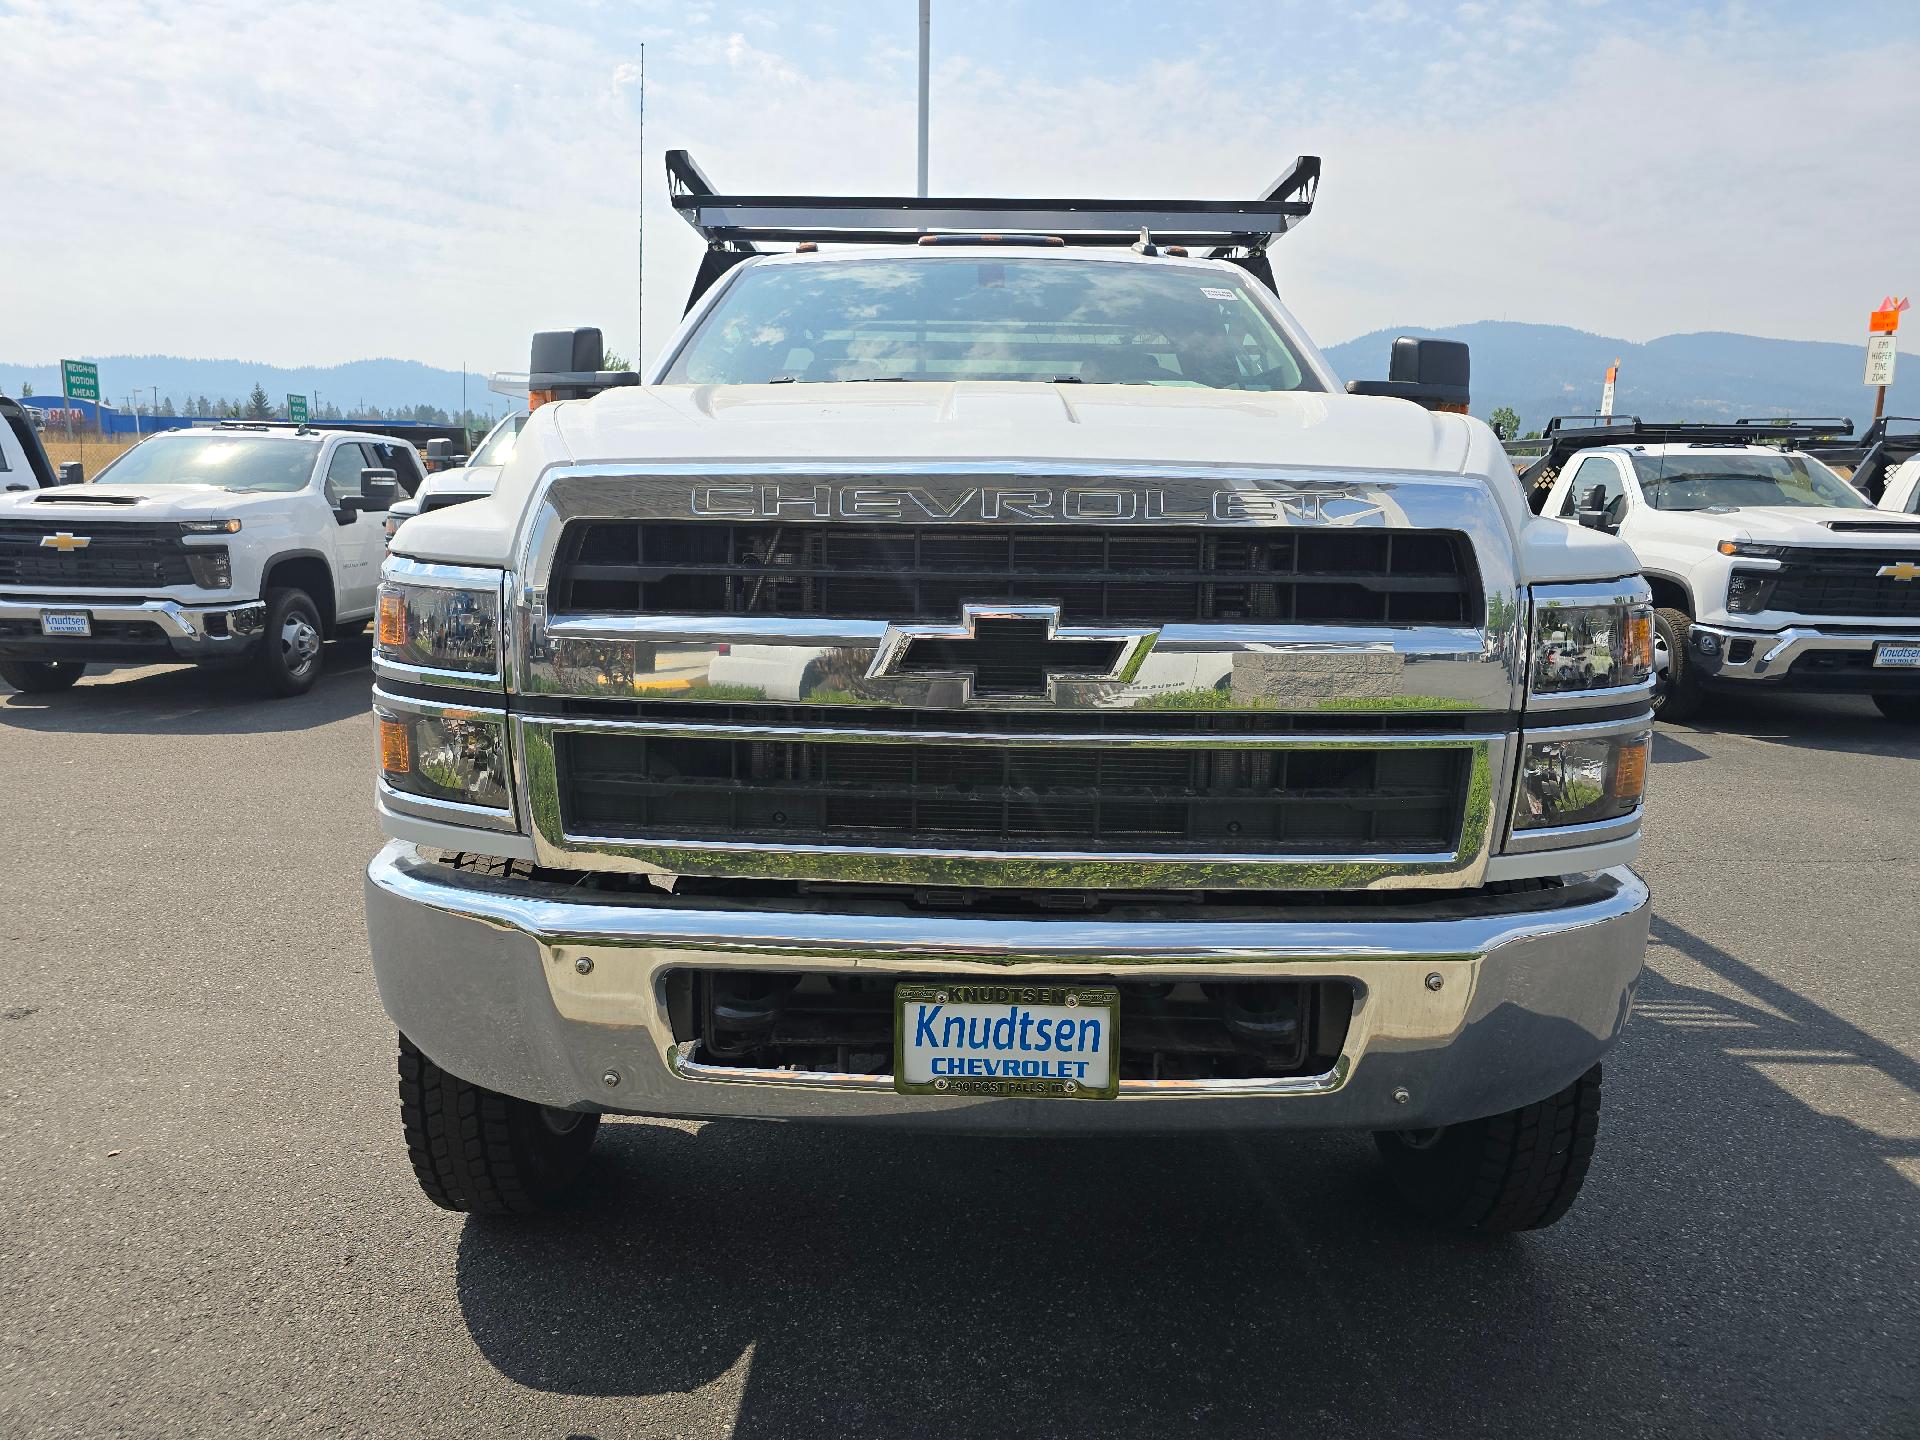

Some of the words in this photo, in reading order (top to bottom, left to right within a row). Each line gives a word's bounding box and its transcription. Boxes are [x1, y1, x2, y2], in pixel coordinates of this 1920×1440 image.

[70, 376, 95, 385] MOTION
[72, 388, 96, 397] AHEAD
[691, 483, 1347, 521] CHEVROLET
[45, 615, 85, 625] Knudtsen
[948, 986, 1066, 1004] KNUDTSEN
[915, 1005, 1101, 1053] Knudtsen
[931, 1057, 1089, 1078] CHEVROLET
[973, 1081, 1005, 1093] POST
